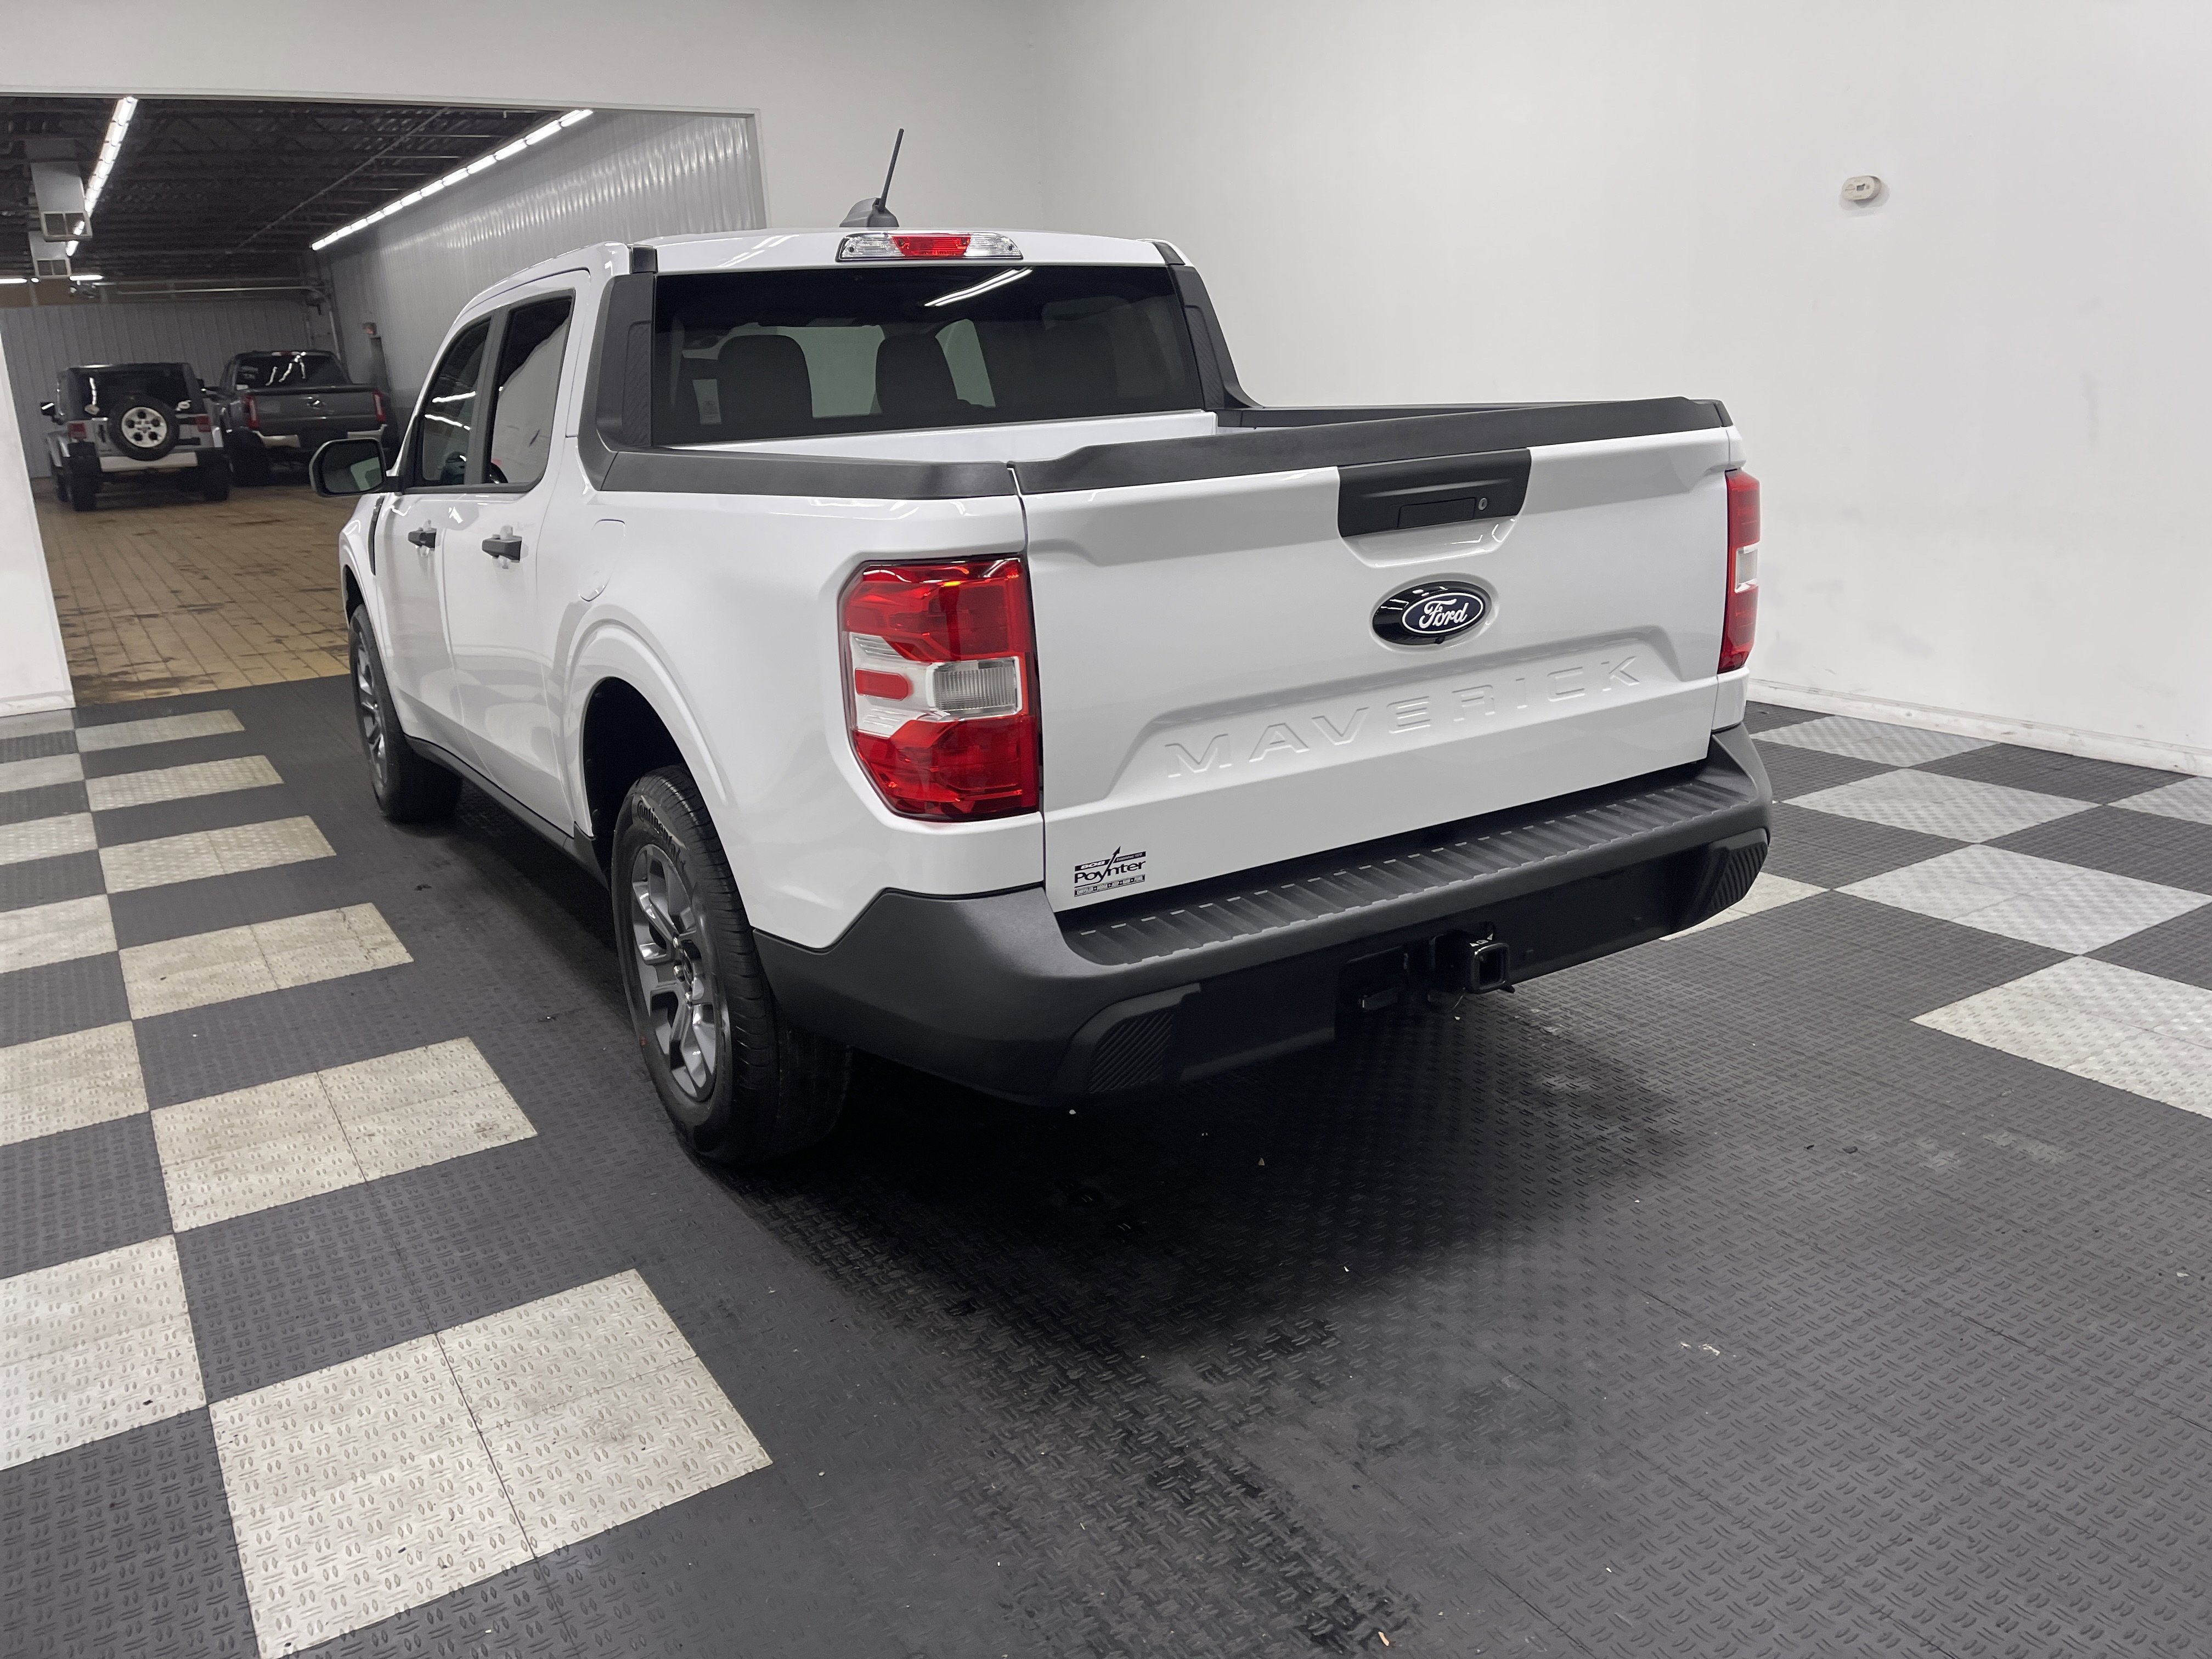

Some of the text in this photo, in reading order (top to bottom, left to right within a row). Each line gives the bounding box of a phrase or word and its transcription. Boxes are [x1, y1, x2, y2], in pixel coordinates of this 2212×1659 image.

[1418, 598, 1469, 629] Ford
[1164, 655, 1640, 778] MAVERICK
[1074, 860, 1146, 887] Poynter
